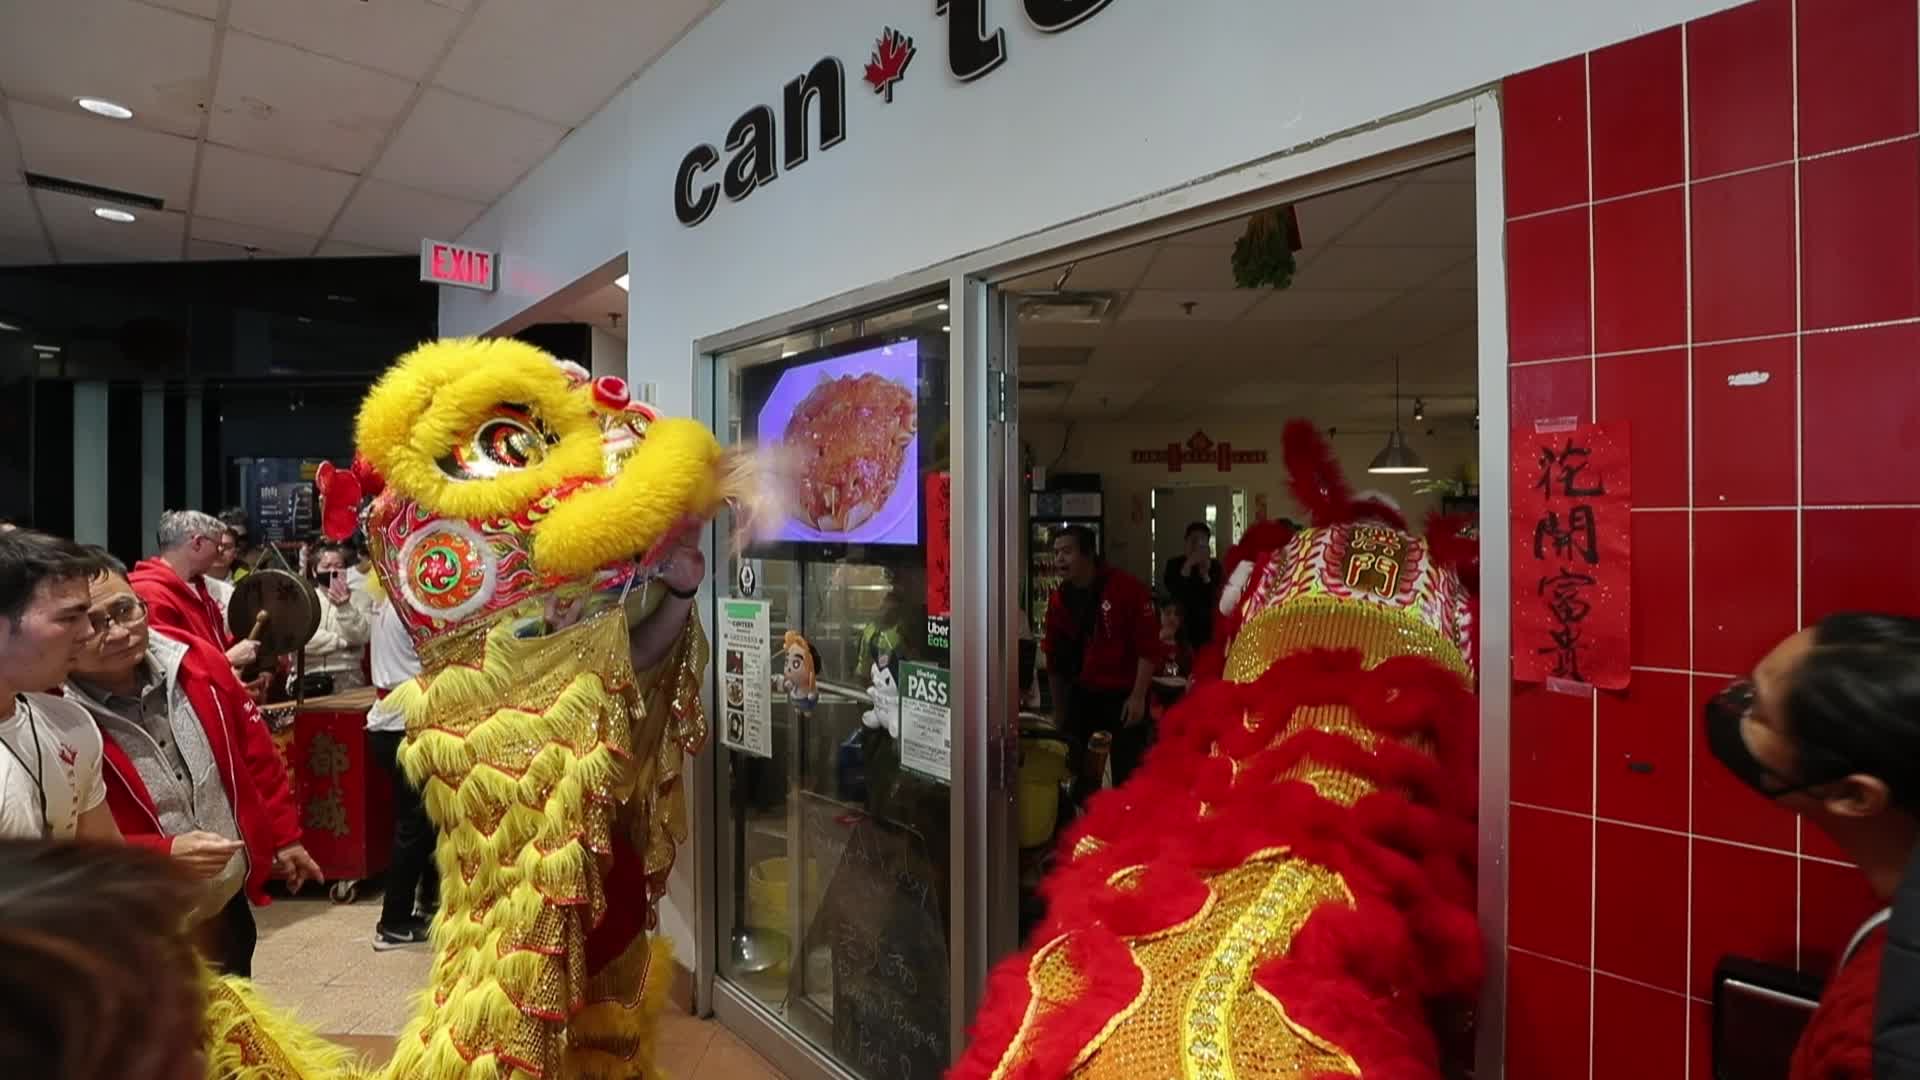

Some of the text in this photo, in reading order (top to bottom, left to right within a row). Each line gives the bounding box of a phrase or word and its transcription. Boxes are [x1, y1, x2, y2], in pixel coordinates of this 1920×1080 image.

[674, 56, 847, 228] can
[432, 244, 490, 285] EXIT
[928, 621, 949, 637] Uber
[928, 634, 949, 649] Eats
[908, 674, 948, 706] PASS
